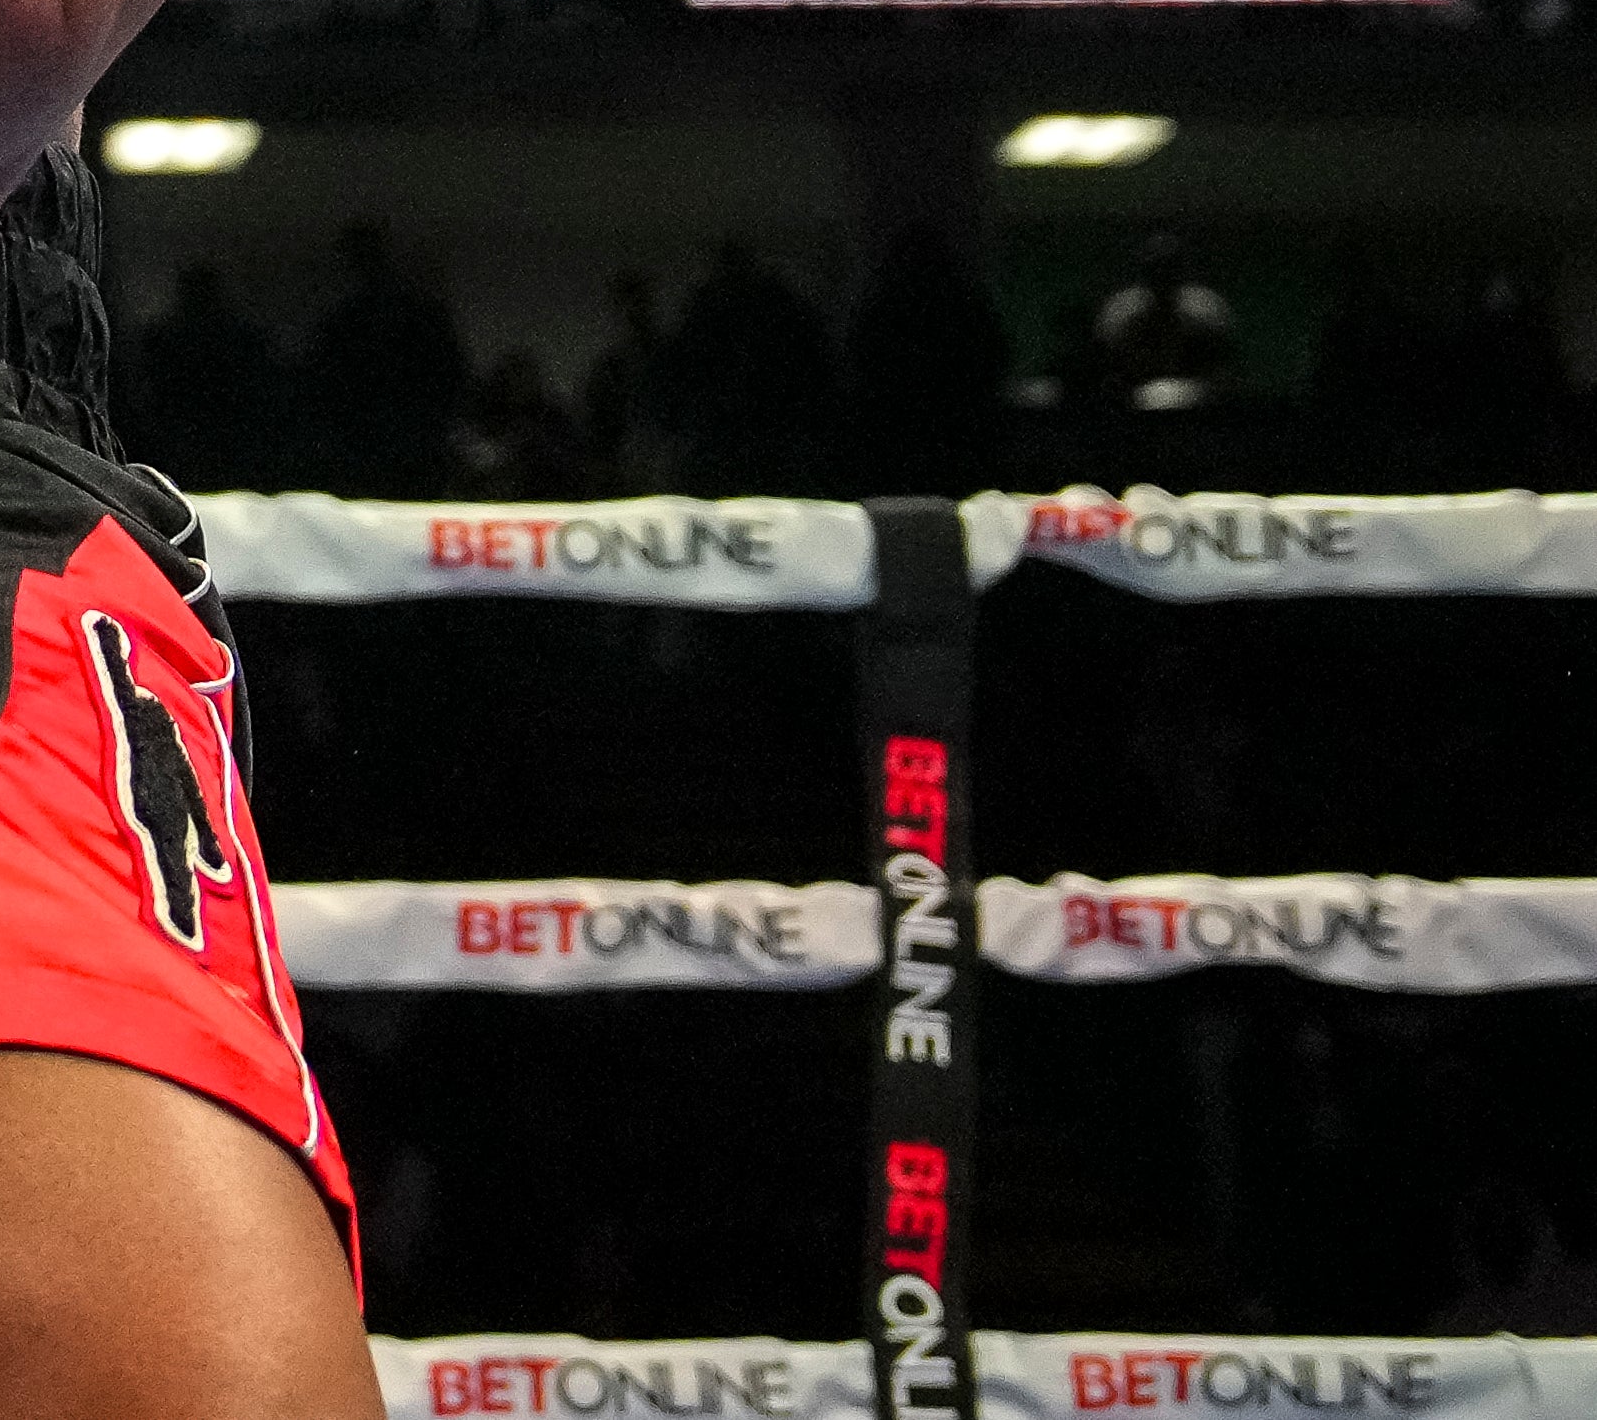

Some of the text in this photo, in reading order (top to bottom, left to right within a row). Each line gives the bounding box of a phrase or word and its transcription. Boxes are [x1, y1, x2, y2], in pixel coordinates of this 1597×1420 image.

[428, 517, 775, 570] BETONLINE
[456, 899, 810, 963] BETONLINE
[883, 735, 960, 1070] BETONLINE
[1063, 895, 1407, 958] BETONLINE
[427, 1355, 792, 1419] BETONLINE
[1067, 1350, 1439, 1412] BETONLINE
